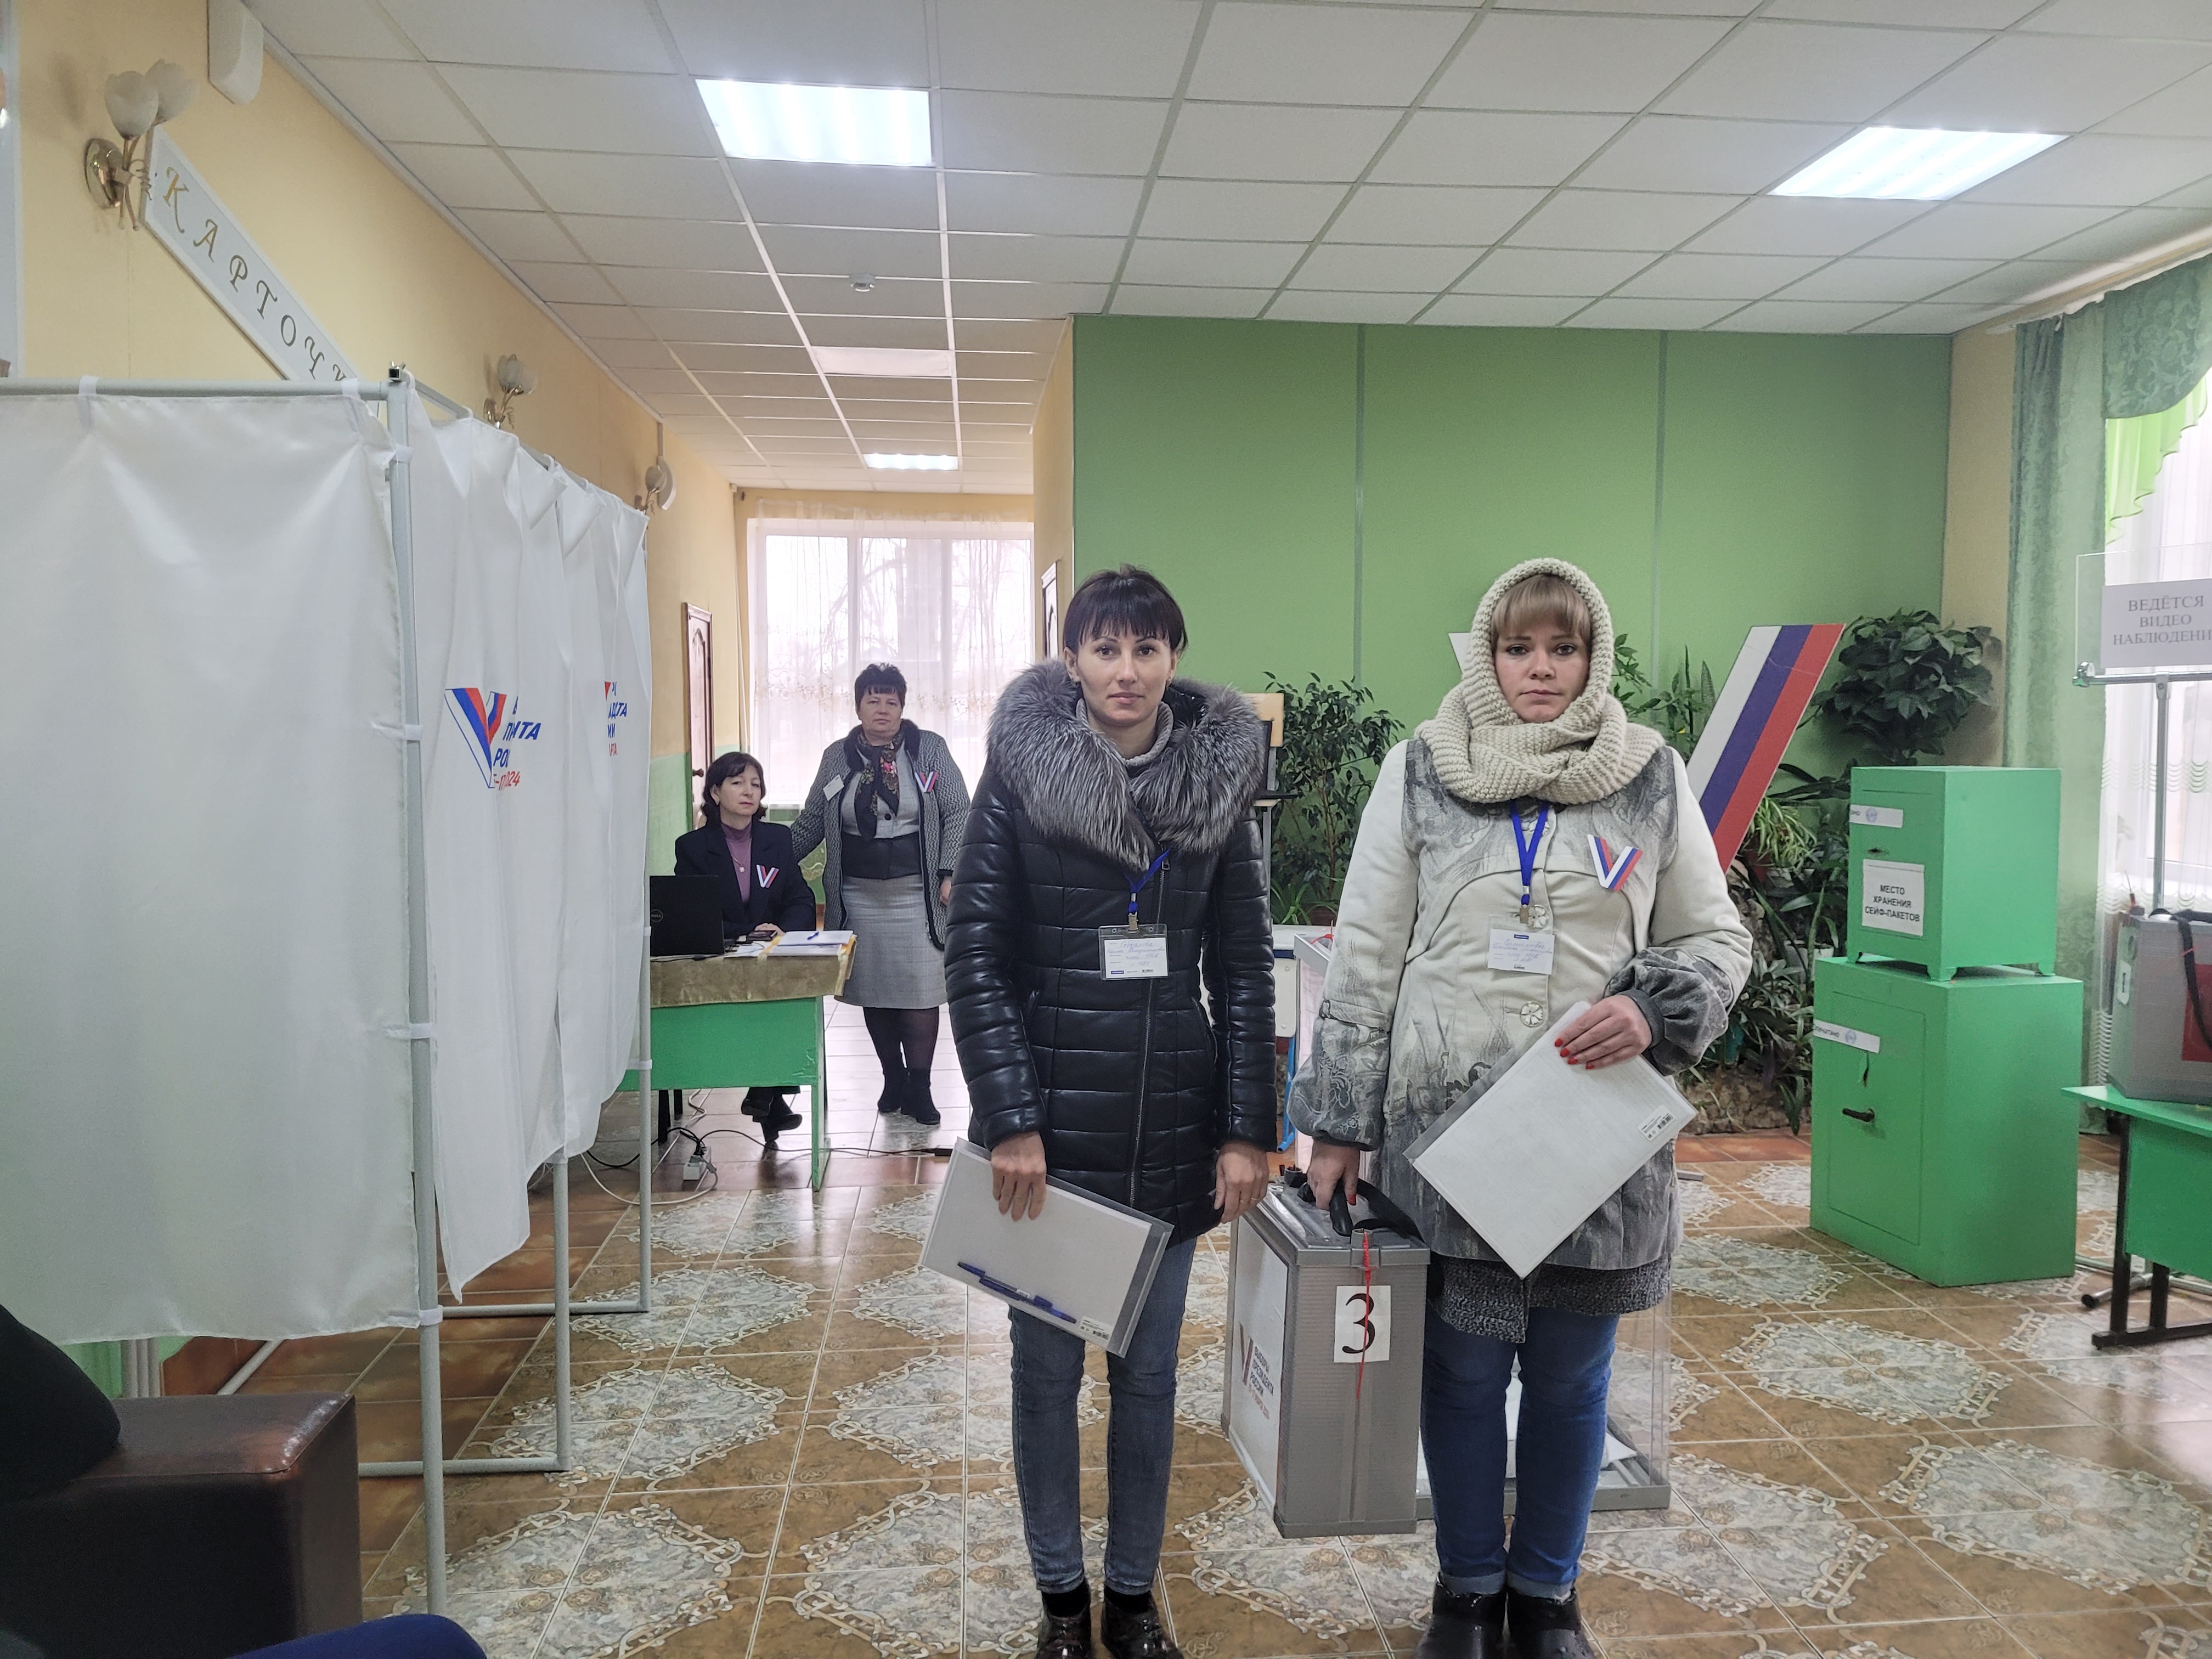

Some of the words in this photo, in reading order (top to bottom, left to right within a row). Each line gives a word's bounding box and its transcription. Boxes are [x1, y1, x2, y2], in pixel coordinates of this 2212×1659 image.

[163, 166, 347, 381] КАРТОЧ
[2128, 595, 2204, 612] ВЕДЁТСЯ
[2140, 614, 2192, 628] ВИДЕО
[1880, 884, 1905, 895] МЕСТО
[1872, 895, 1912, 909] ХРАНЕНИЯ
[1865, 905, 1920, 922] СЕЙФ-ПАКЕТОВ
[1342, 1293, 1375, 1353] 3
